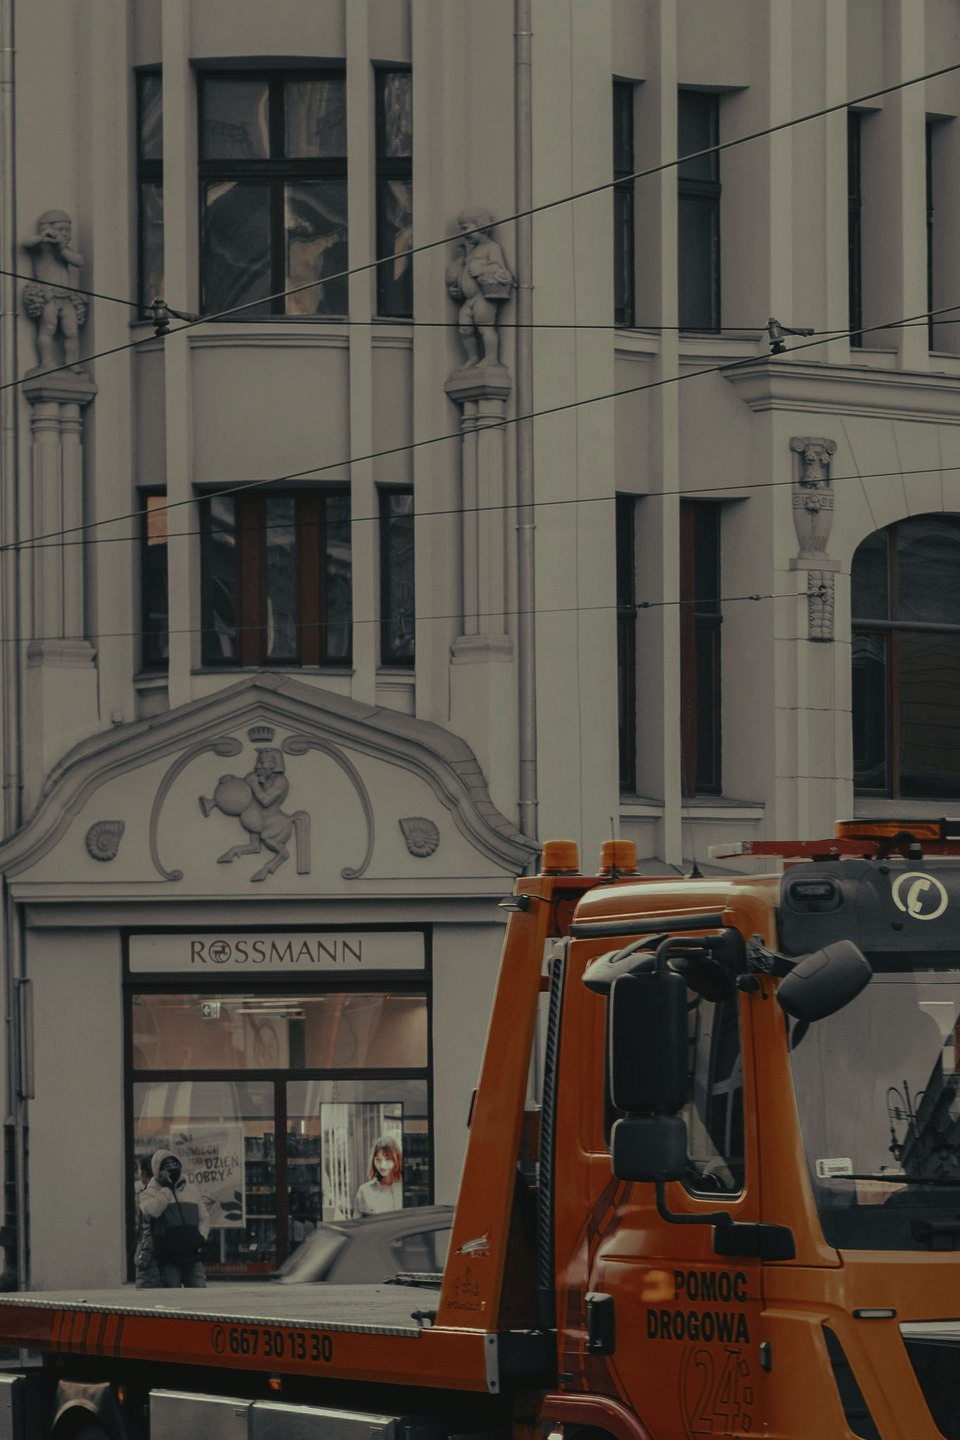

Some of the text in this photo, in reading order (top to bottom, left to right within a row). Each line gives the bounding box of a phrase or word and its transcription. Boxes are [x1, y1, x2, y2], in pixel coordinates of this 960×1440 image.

[190, 939, 362, 964] ROSSMANN
[674, 1270, 748, 1303] POMOC
[646, 1308, 750, 1343] DROGOWA
[230, 1327, 333, 1362] 667 30 13 30
